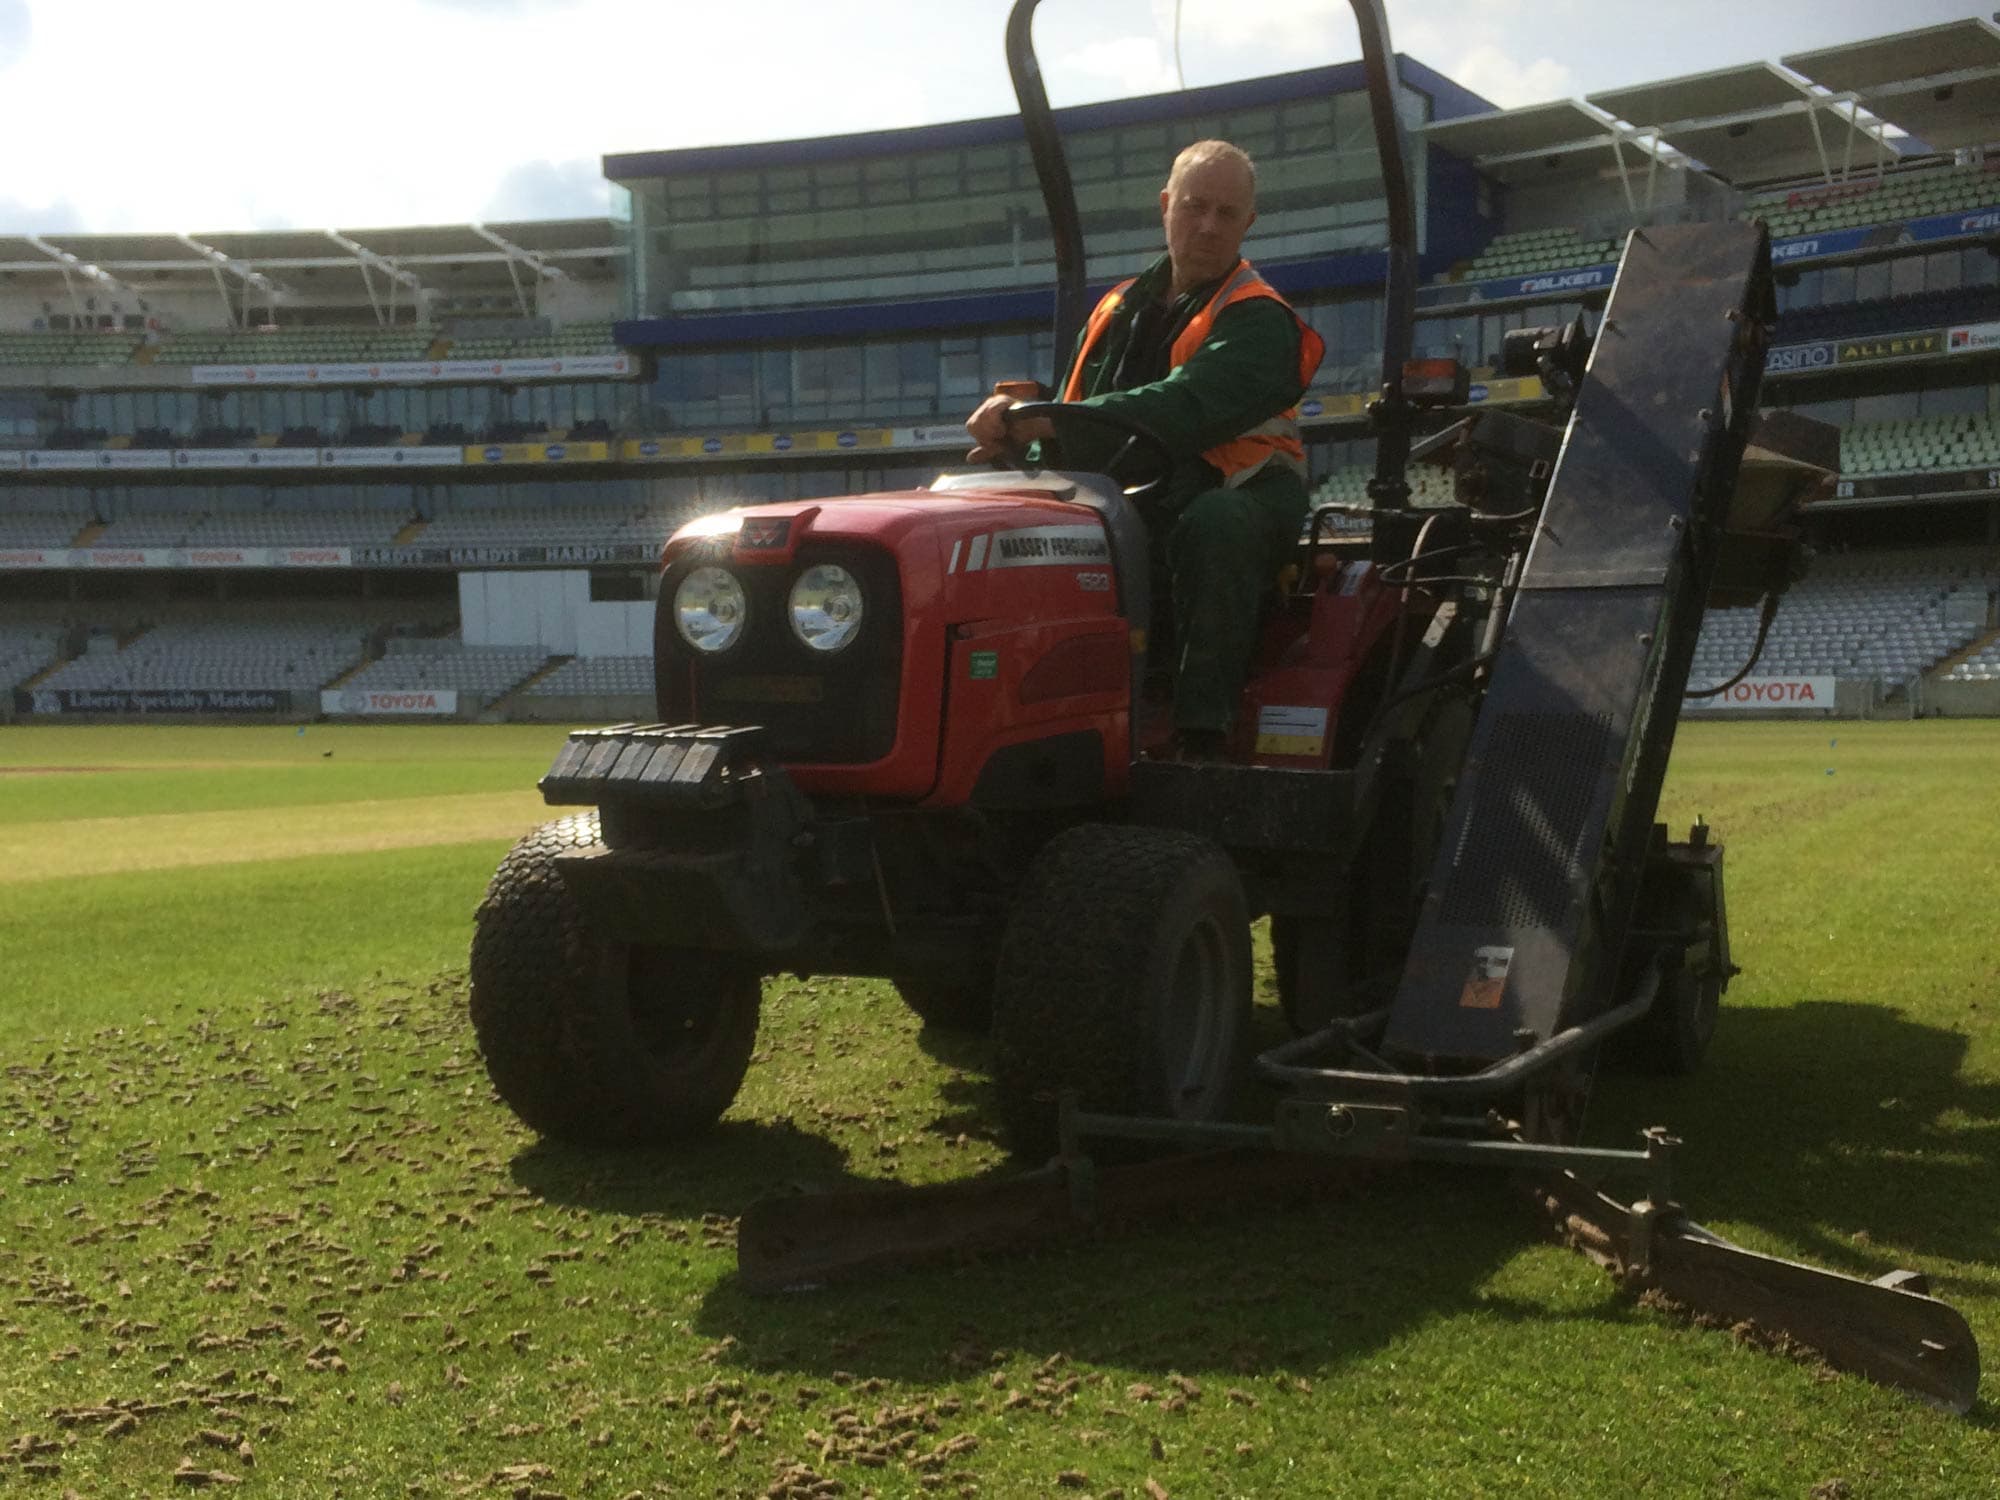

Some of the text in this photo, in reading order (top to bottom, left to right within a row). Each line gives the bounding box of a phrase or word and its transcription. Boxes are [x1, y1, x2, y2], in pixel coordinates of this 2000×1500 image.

[1770, 241, 1818, 259] KEN
[1844, 336, 1934, 358] ALLETT
[999, 537, 1048, 559] MASSEY
[370, 694, 436, 709] TOYOTA
[1723, 682, 1815, 702] TOYOTA
